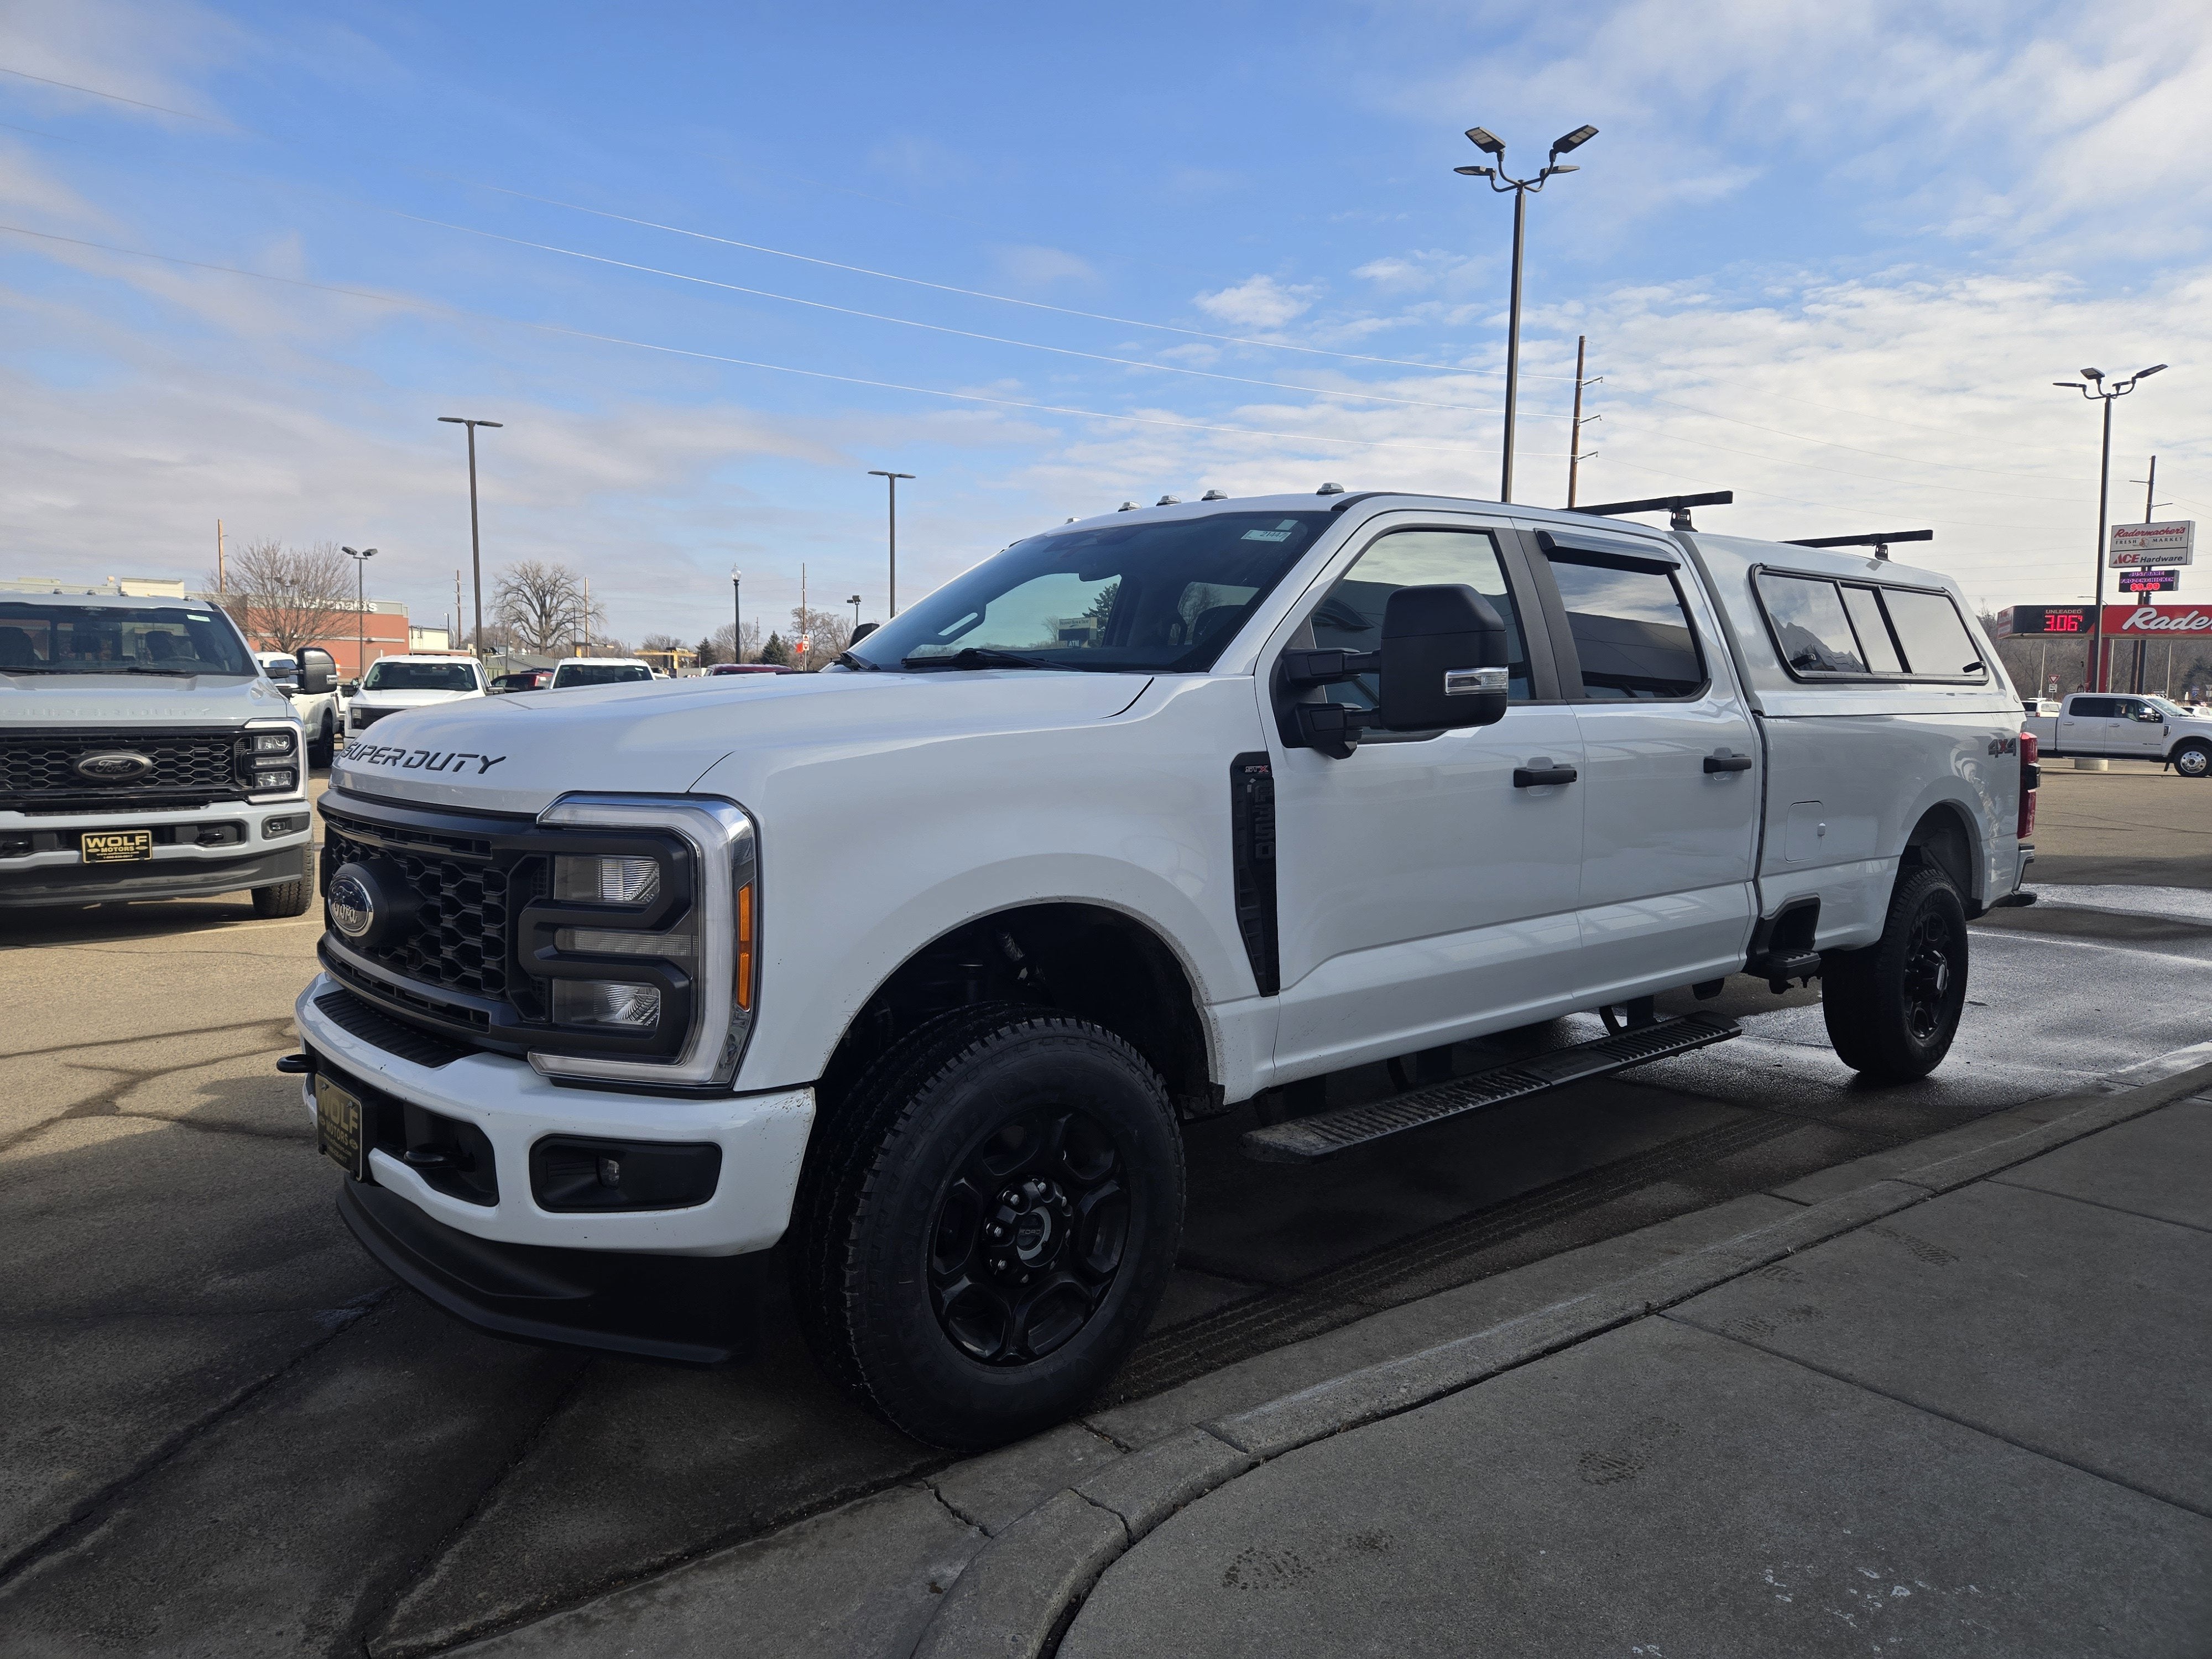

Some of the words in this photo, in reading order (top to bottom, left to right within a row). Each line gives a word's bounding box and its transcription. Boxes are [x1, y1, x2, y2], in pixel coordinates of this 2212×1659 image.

[2114, 526, 2186, 538] Radermacher's
[2113, 553, 2140, 565] ACE
[2130, 582, 2161, 591] $9.99
[2122, 607, 2212, 630] Rade
[341, 742, 406, 766] SUPER
[402, 750, 507, 774] DUTY
[95, 760, 131, 773] Ford
[86, 835, 147, 848] WOLF
[316, 1091, 358, 1134] WOLF
[326, 1119, 348, 1146] MOTORS
